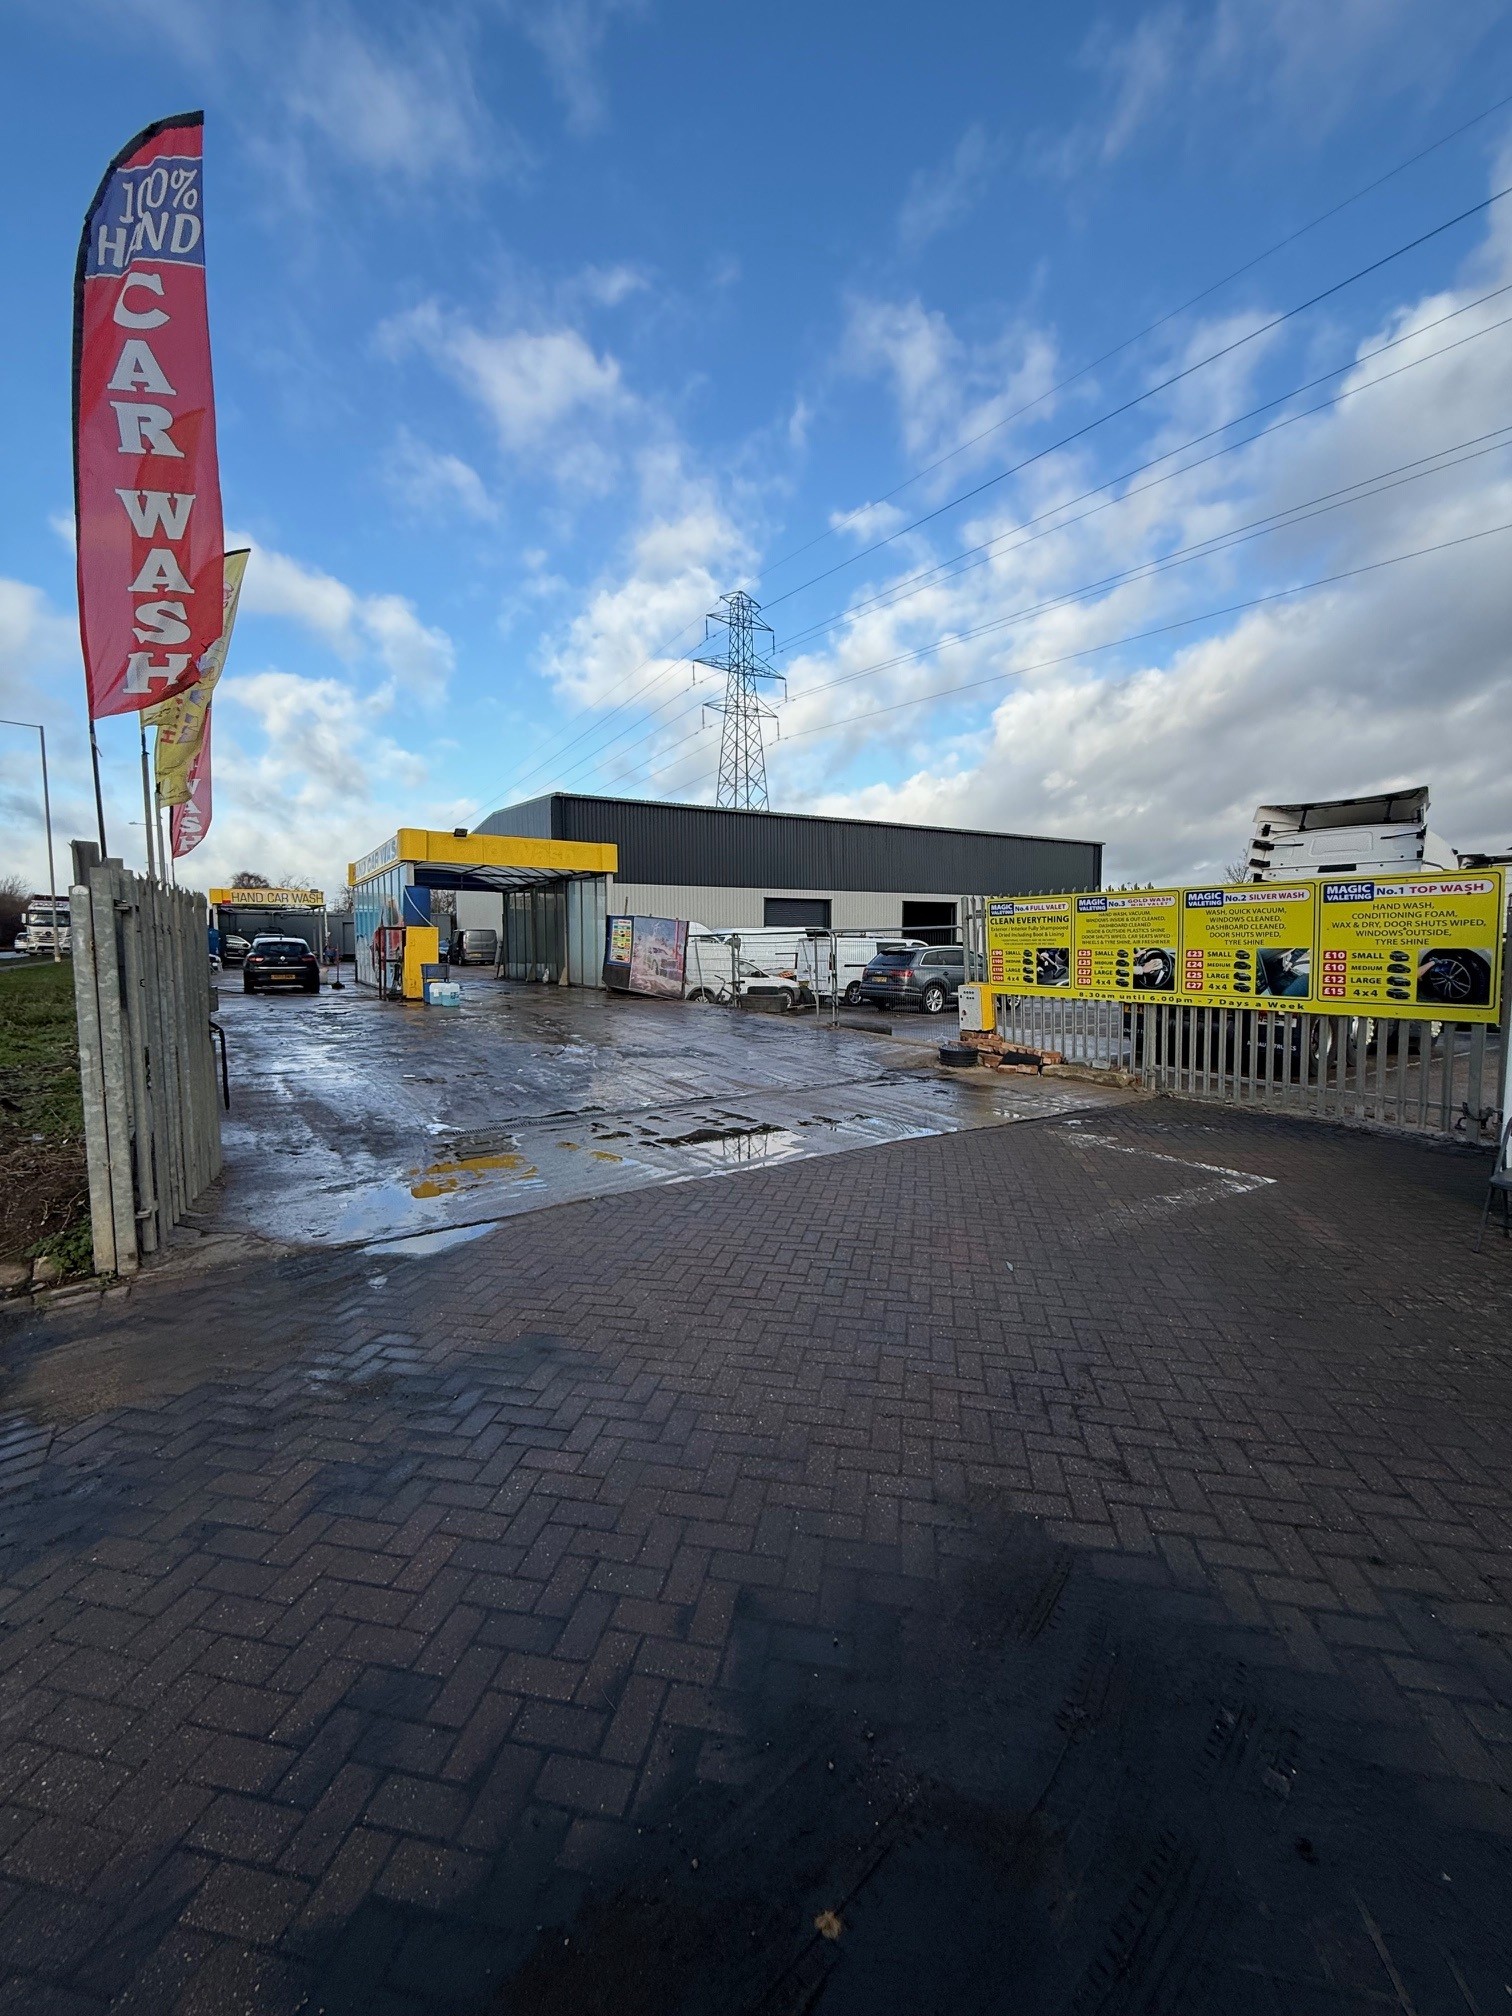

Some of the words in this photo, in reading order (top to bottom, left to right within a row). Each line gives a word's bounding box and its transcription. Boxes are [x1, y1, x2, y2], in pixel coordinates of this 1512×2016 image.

[119, 168, 198, 223] 100%
[98, 211, 201, 267] HAND
[107, 272, 185, 458] CAR
[115, 488, 196, 693] WASH
[1327, 884, 1371, 894] MAGIC
[1377, 887, 1404, 895] No.1
[1409, 886, 1437, 894] TOP
[1441, 884, 1484, 892] WASH
[232, 893, 263, 903] HAND
[267, 893, 288, 903] CAR
[291, 893, 324, 903] WASH
[1188, 892, 1221, 900] MAGIC
[1327, 892, 1371, 900] VALETING
[1352, 911, 1422, 919] CONDITIONING
[1425, 910, 1458, 918] FOAM,
[1017, 916, 1069, 924] EVERYTHING
[1361, 921, 1381, 929] DRY,
[1450, 919, 1486, 927] WIPED,
[1406, 929, 1451, 937] OUTSIDE,
[1325, 964, 1345, 972] £10
[1324, 976, 1344, 984] £12
[1150, 996, 1192, 1005] 6.00pm
[1219, 999, 1249, 1008] Days
[1268, 1002, 1304, 1010] Week
